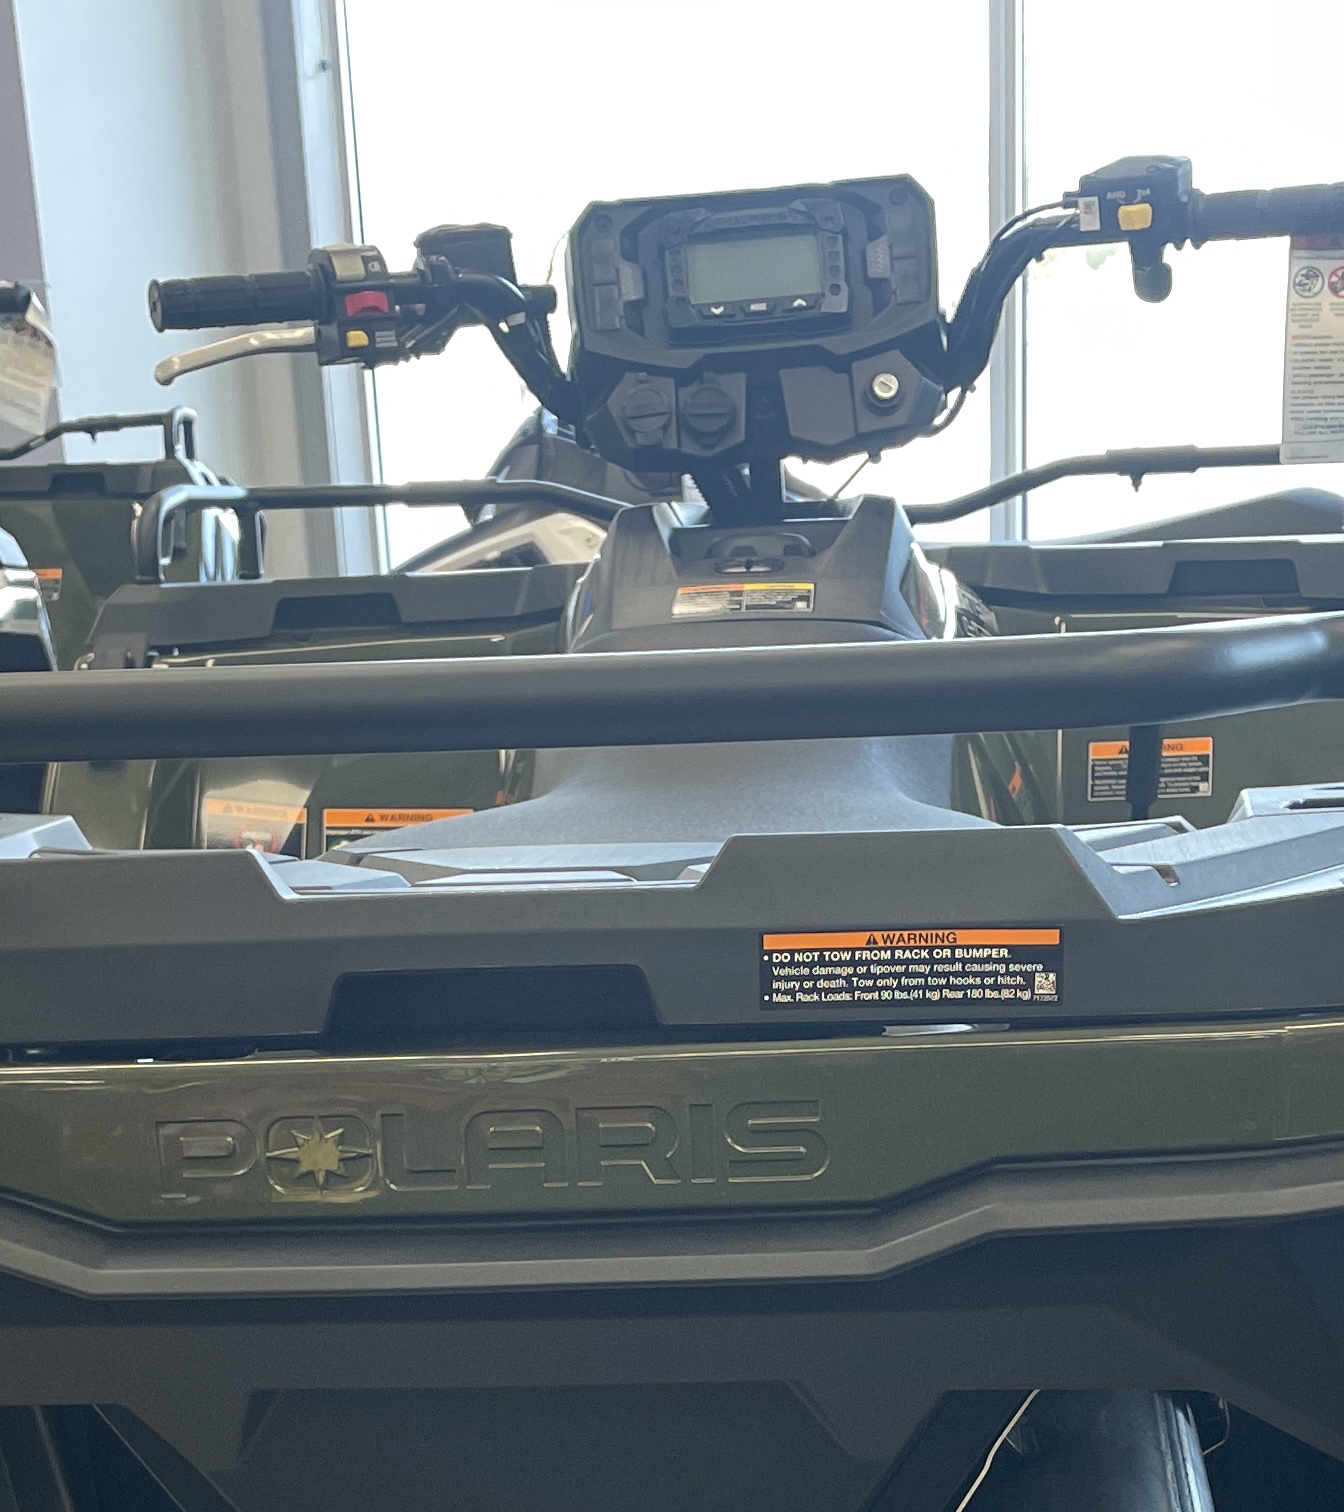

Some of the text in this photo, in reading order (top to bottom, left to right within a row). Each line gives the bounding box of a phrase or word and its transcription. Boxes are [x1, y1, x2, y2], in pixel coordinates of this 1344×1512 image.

[379, 813, 434, 822] WARNING
[881, 931, 957, 945] WARNING
[772, 947, 1012, 963] DO NOT TOW FROM RACK OR BUMPER.
[772, 961, 1044, 977] Vehicle damage or tipover may result causing severe
[772, 974, 1027, 991] injury or death. Tow only from tow hooks or hitch.
[772, 992, 794, 1003] Max.
[796, 991, 820, 1002] Rack
[821, 991, 853, 1002] Loads:
[854, 990, 879, 1001] Front
[880, 990, 893, 1000] 90
[925, 988, 941, 1001] kg)
[942, 989, 965, 999] Rear
[966, 988, 984, 999] 180
[1017, 988, 1032, 1000] kg)
[155, 1099, 832, 1201] POLARIS
